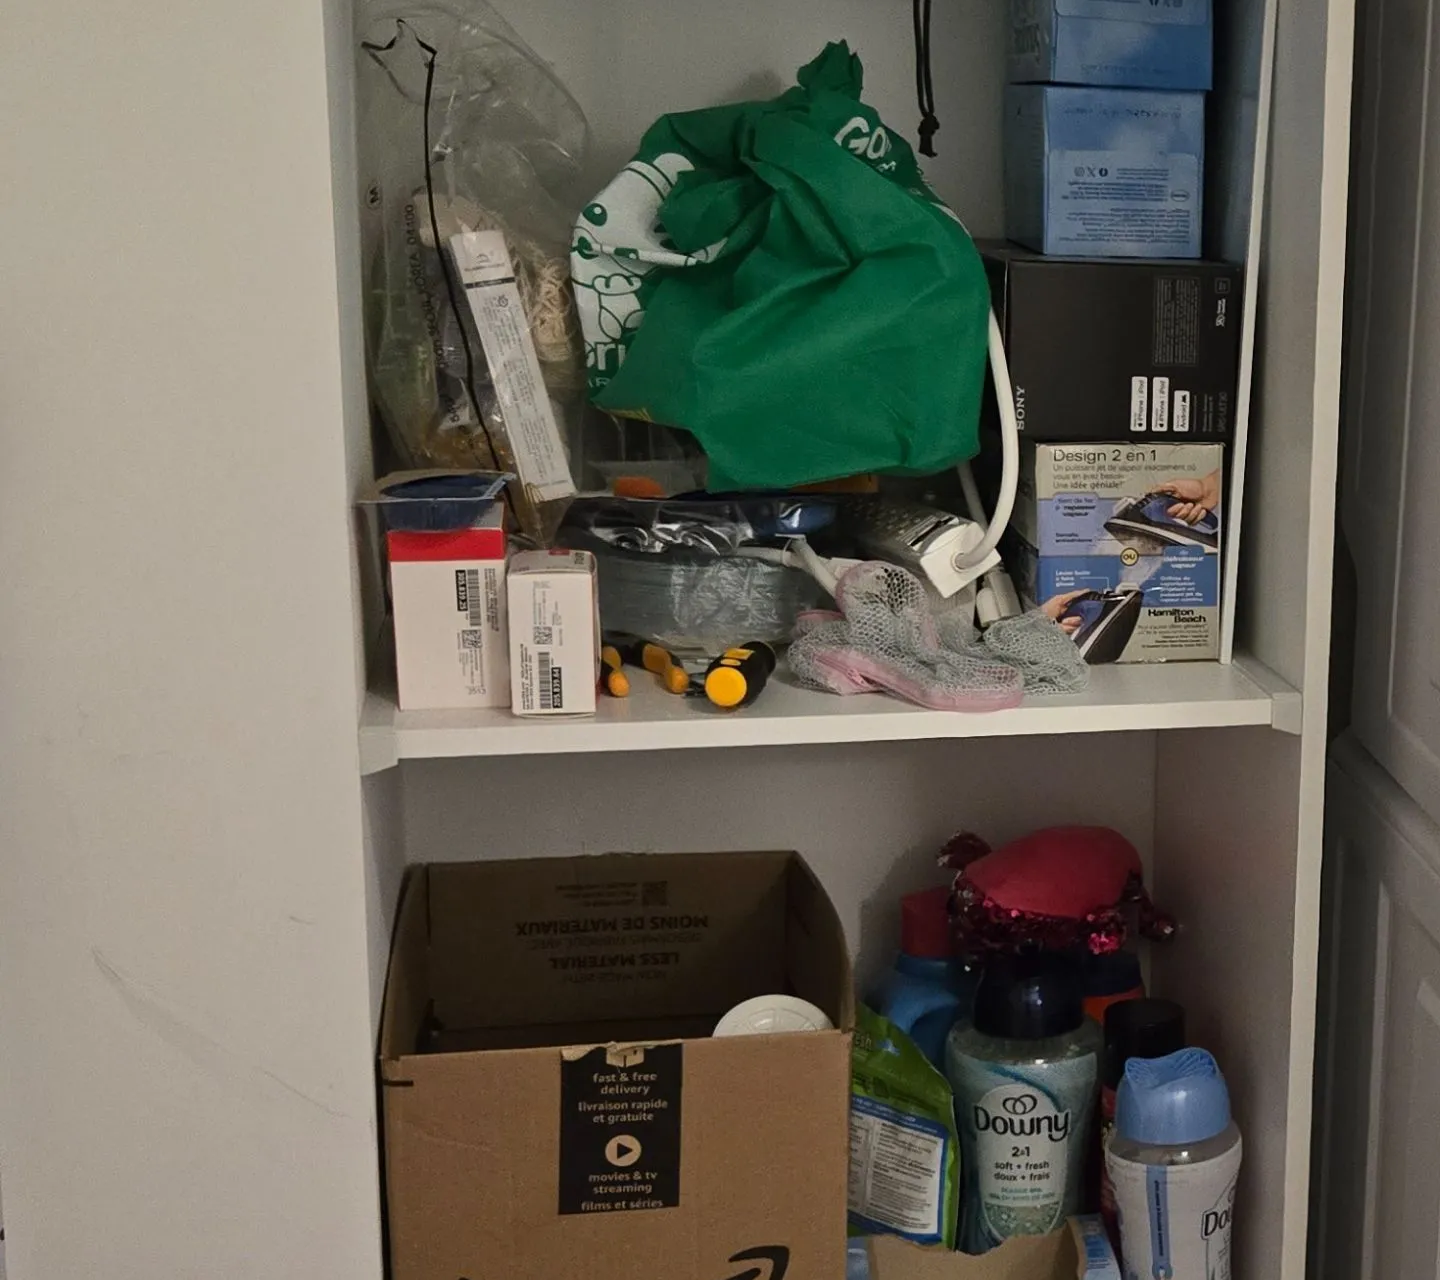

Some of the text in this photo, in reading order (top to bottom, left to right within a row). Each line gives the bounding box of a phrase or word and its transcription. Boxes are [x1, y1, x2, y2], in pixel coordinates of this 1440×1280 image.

[1016, 385, 1025, 431] SONY
[1053, 449, 1156, 464] Design 2 en 1
[1070, 481, 1088, 489] idée
[1123, 552, 1137, 562] OU
[1148, 609, 1194, 617] Hamilton
[1174, 615, 1207, 623] Beach
[623, 917, 645, 931] DE
[548, 952, 680, 969] LESS MATERIAL
[593, 1072, 658, 1083] fast & free
[600, 1085, 650, 1095] delivery
[578, 1099, 668, 1112] livraison rapide
[593, 1112, 654, 1125] et gratuite
[974, 1105, 1070, 1142] Downy
[995, 1161, 1013, 1170] soft
[1025, 1161, 1049, 1170] fresh
[588, 1171, 658, 1182] movies & tv
[994, 1172, 1017, 1181] doux
[1030, 1172, 1050, 1181] frais
[593, 1184, 652, 1194] streaming
[581, 1199, 663, 1211] films et séries
